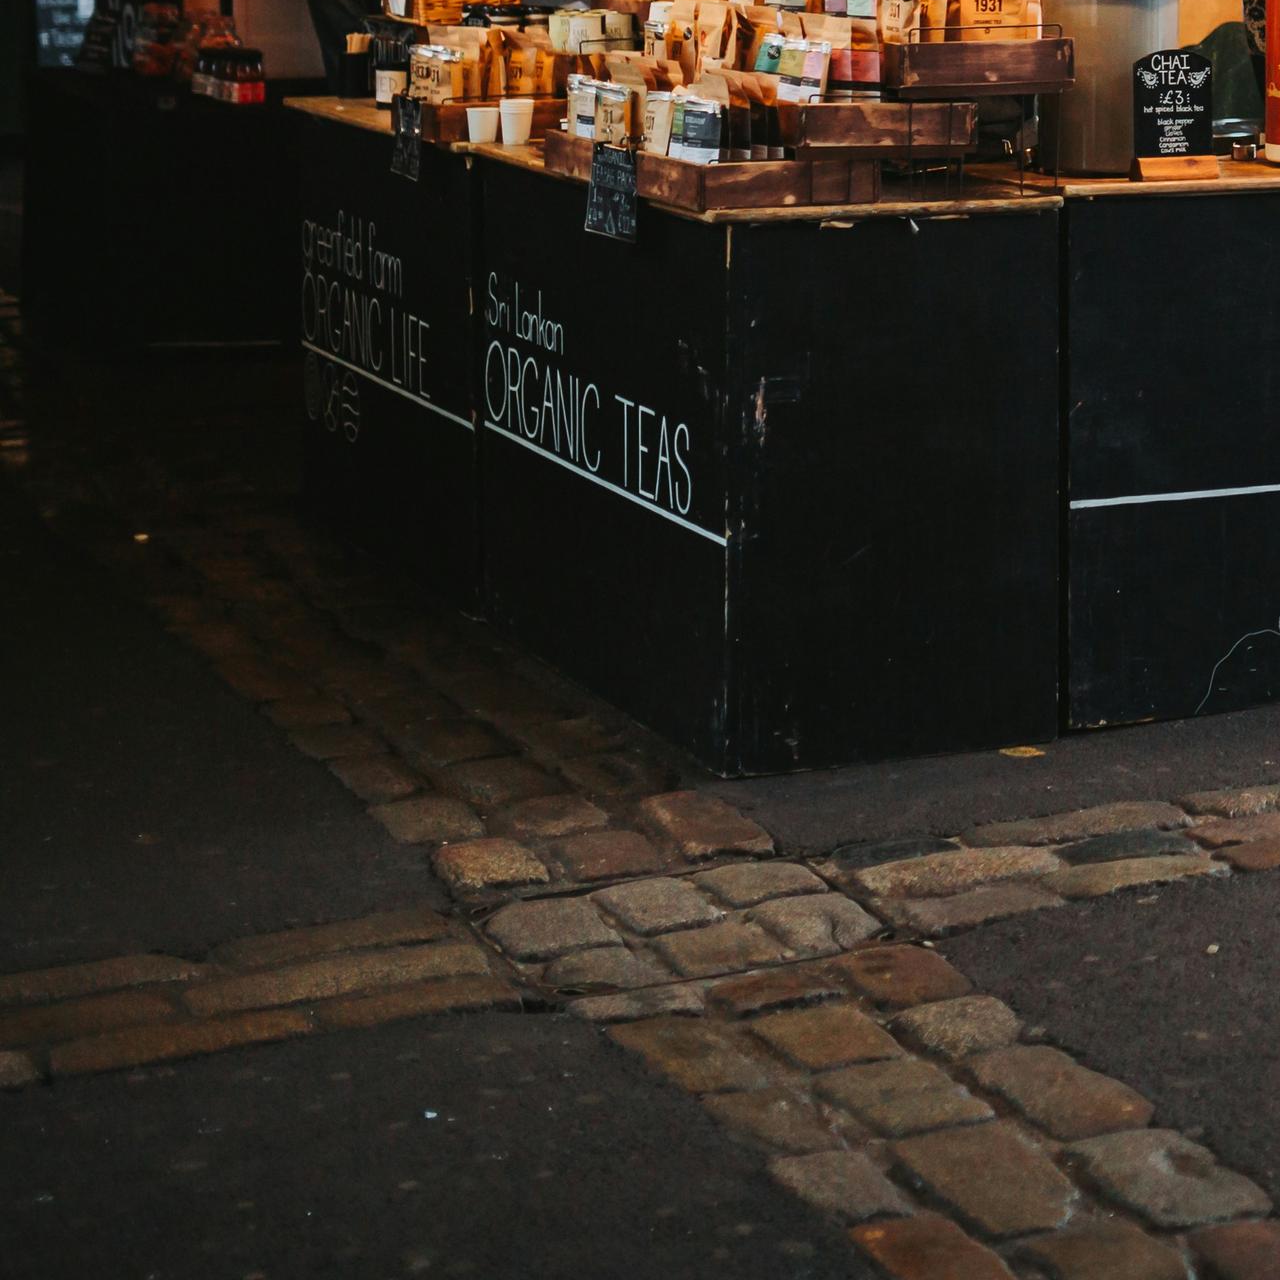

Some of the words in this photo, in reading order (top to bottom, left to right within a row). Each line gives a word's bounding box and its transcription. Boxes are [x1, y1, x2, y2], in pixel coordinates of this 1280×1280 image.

[1151, 54, 1190, 71] CHAI
[1159, 70, 1187, 85] TEA
[1162, 90, 1184, 104] £3
[1155, 105, 1174, 114] spiced
[1176, 104, 1192, 112] black
[1157, 118, 1174, 126] black
[1175, 118, 1194, 127] pepper
[369, 222, 402, 299] farm
[488, 272, 509, 332] Sri
[515, 281, 564, 355] Lankan
[302, 272, 382, 371] ORGANIC
[391, 307, 430, 399] LIFE
[485, 340, 600, 472] ORGANIC
[614, 394, 691, 514] TEAS
